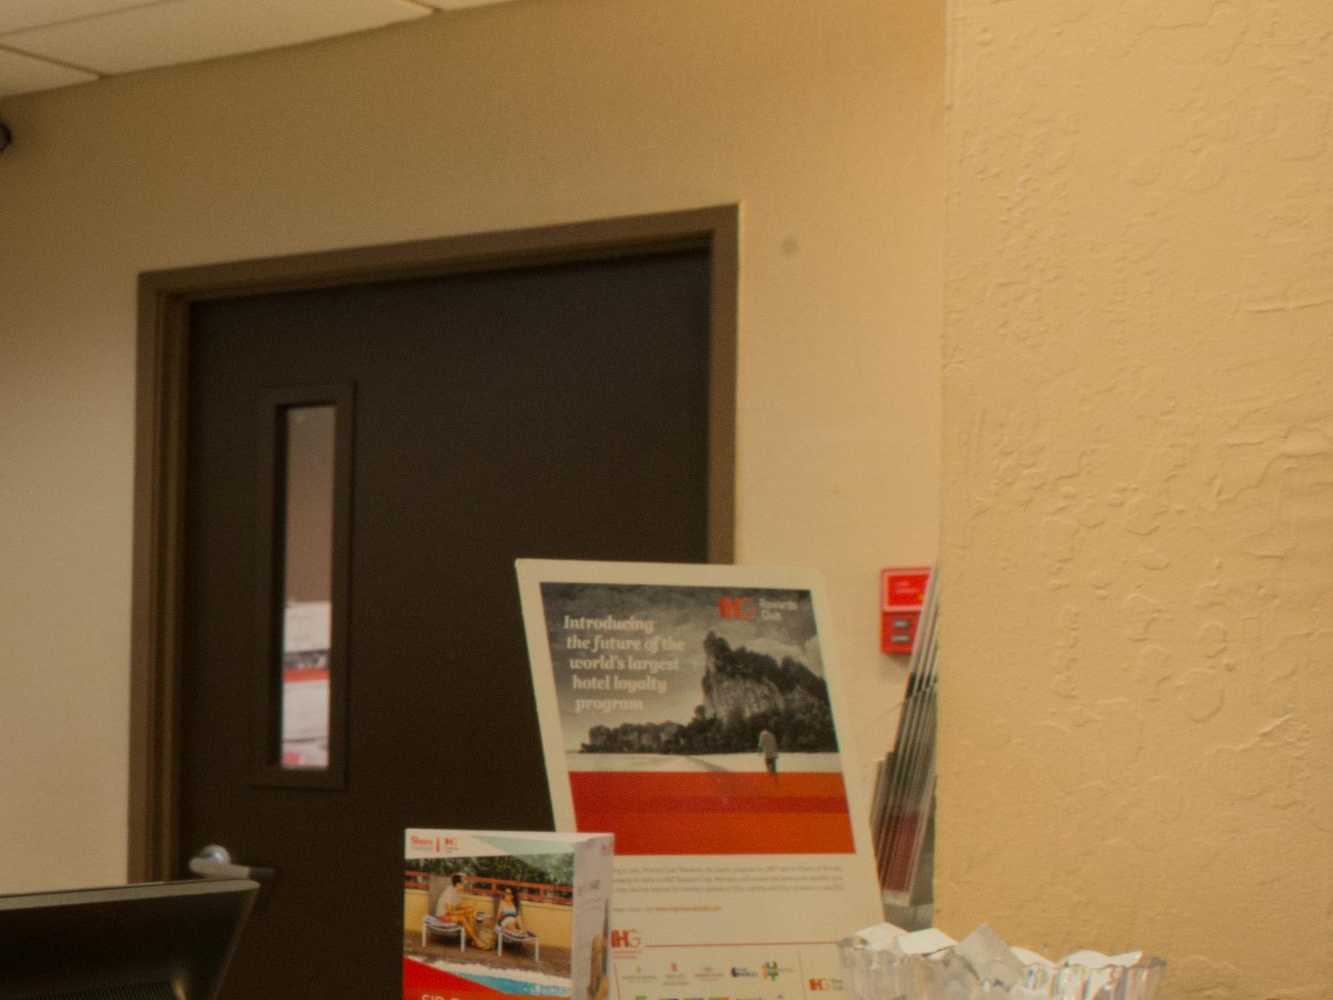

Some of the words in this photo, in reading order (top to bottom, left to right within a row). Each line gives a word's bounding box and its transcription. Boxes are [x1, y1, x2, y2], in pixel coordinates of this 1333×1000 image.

[564, 615, 654, 633] Introducing
[566, 635, 591, 650] the
[592, 636, 642, 652] future
[644, 636, 661, 651] of
[660, 637, 685, 651] the
[569, 656, 625, 671] world's
[628, 656, 680, 673] largest
[572, 674, 610, 690] hotel
[613, 675, 667, 694] loyalty
